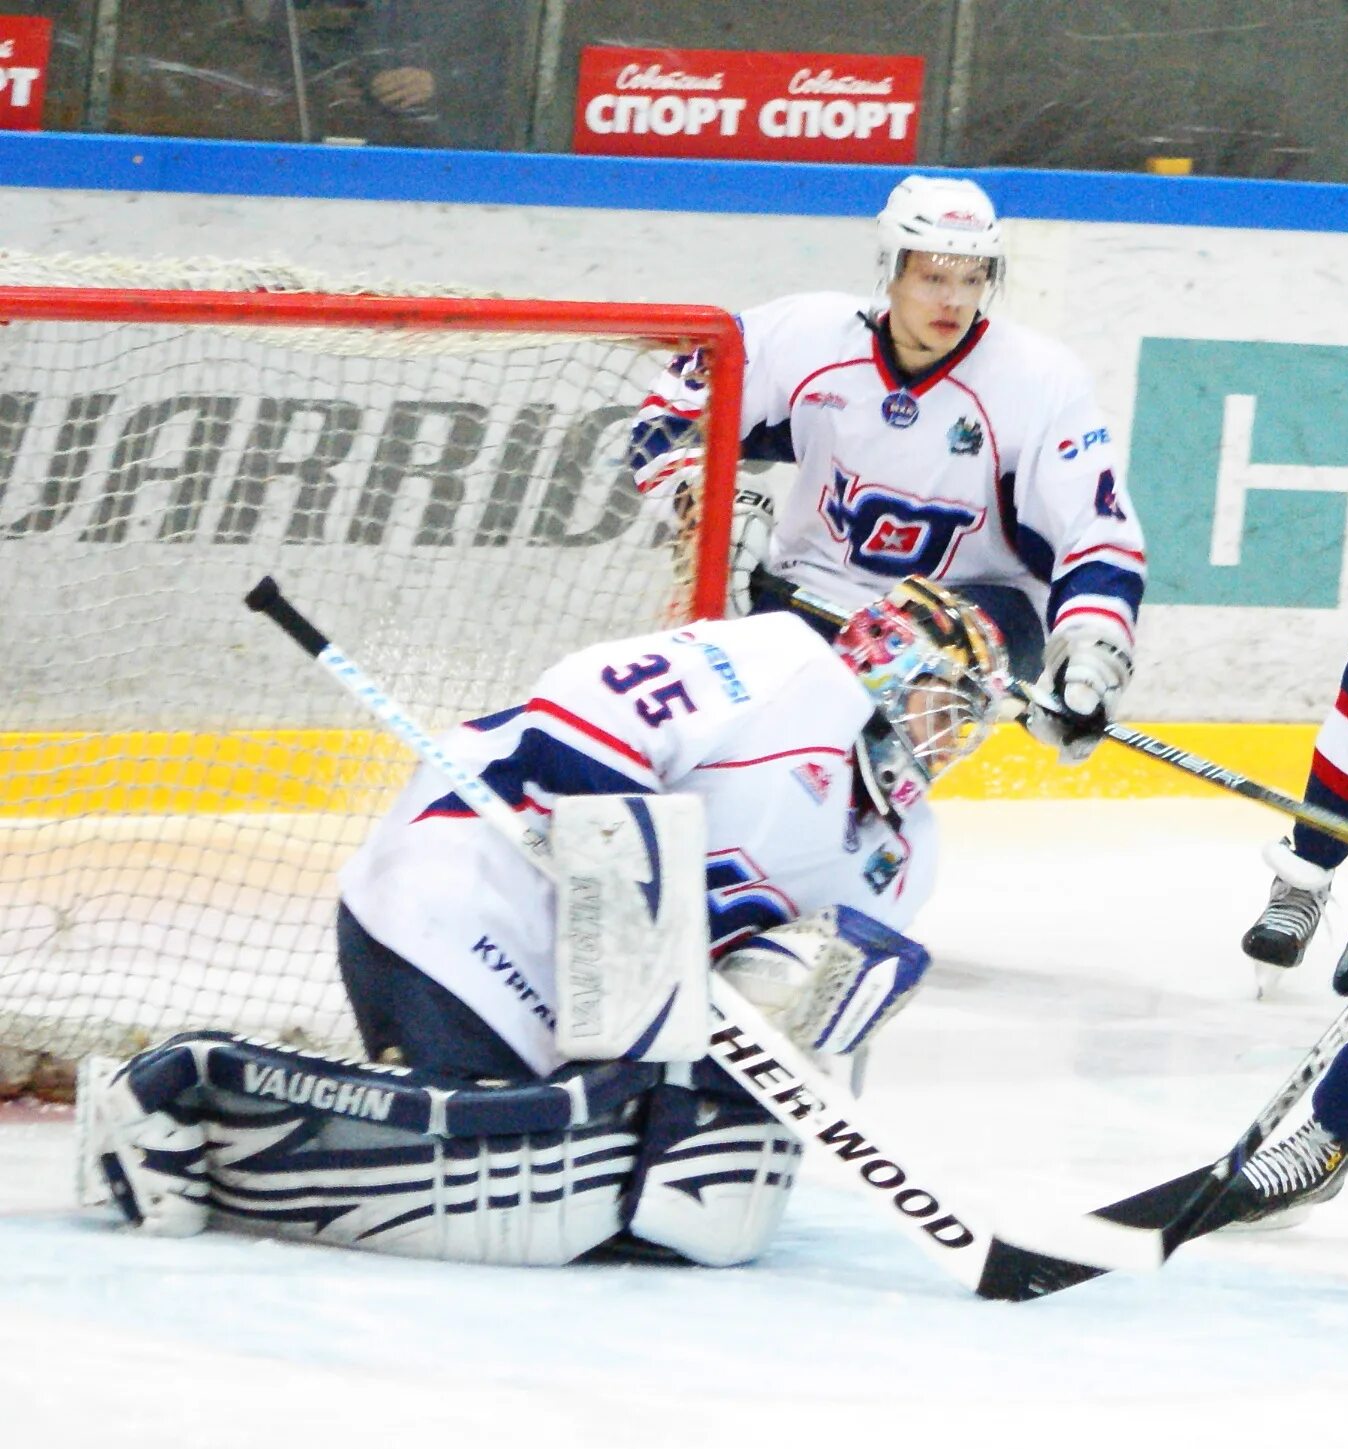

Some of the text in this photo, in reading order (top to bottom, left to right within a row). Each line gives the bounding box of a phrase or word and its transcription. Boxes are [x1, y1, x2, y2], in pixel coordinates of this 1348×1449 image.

[616, 63, 725, 91] Советский
[787, 68, 893, 95] Советский
[585, 93, 747, 136] СПОРТ
[758, 98, 915, 141] СПОРТ
[601, 653, 698, 728] 35
[243, 1062, 396, 1122] VAUGHN
